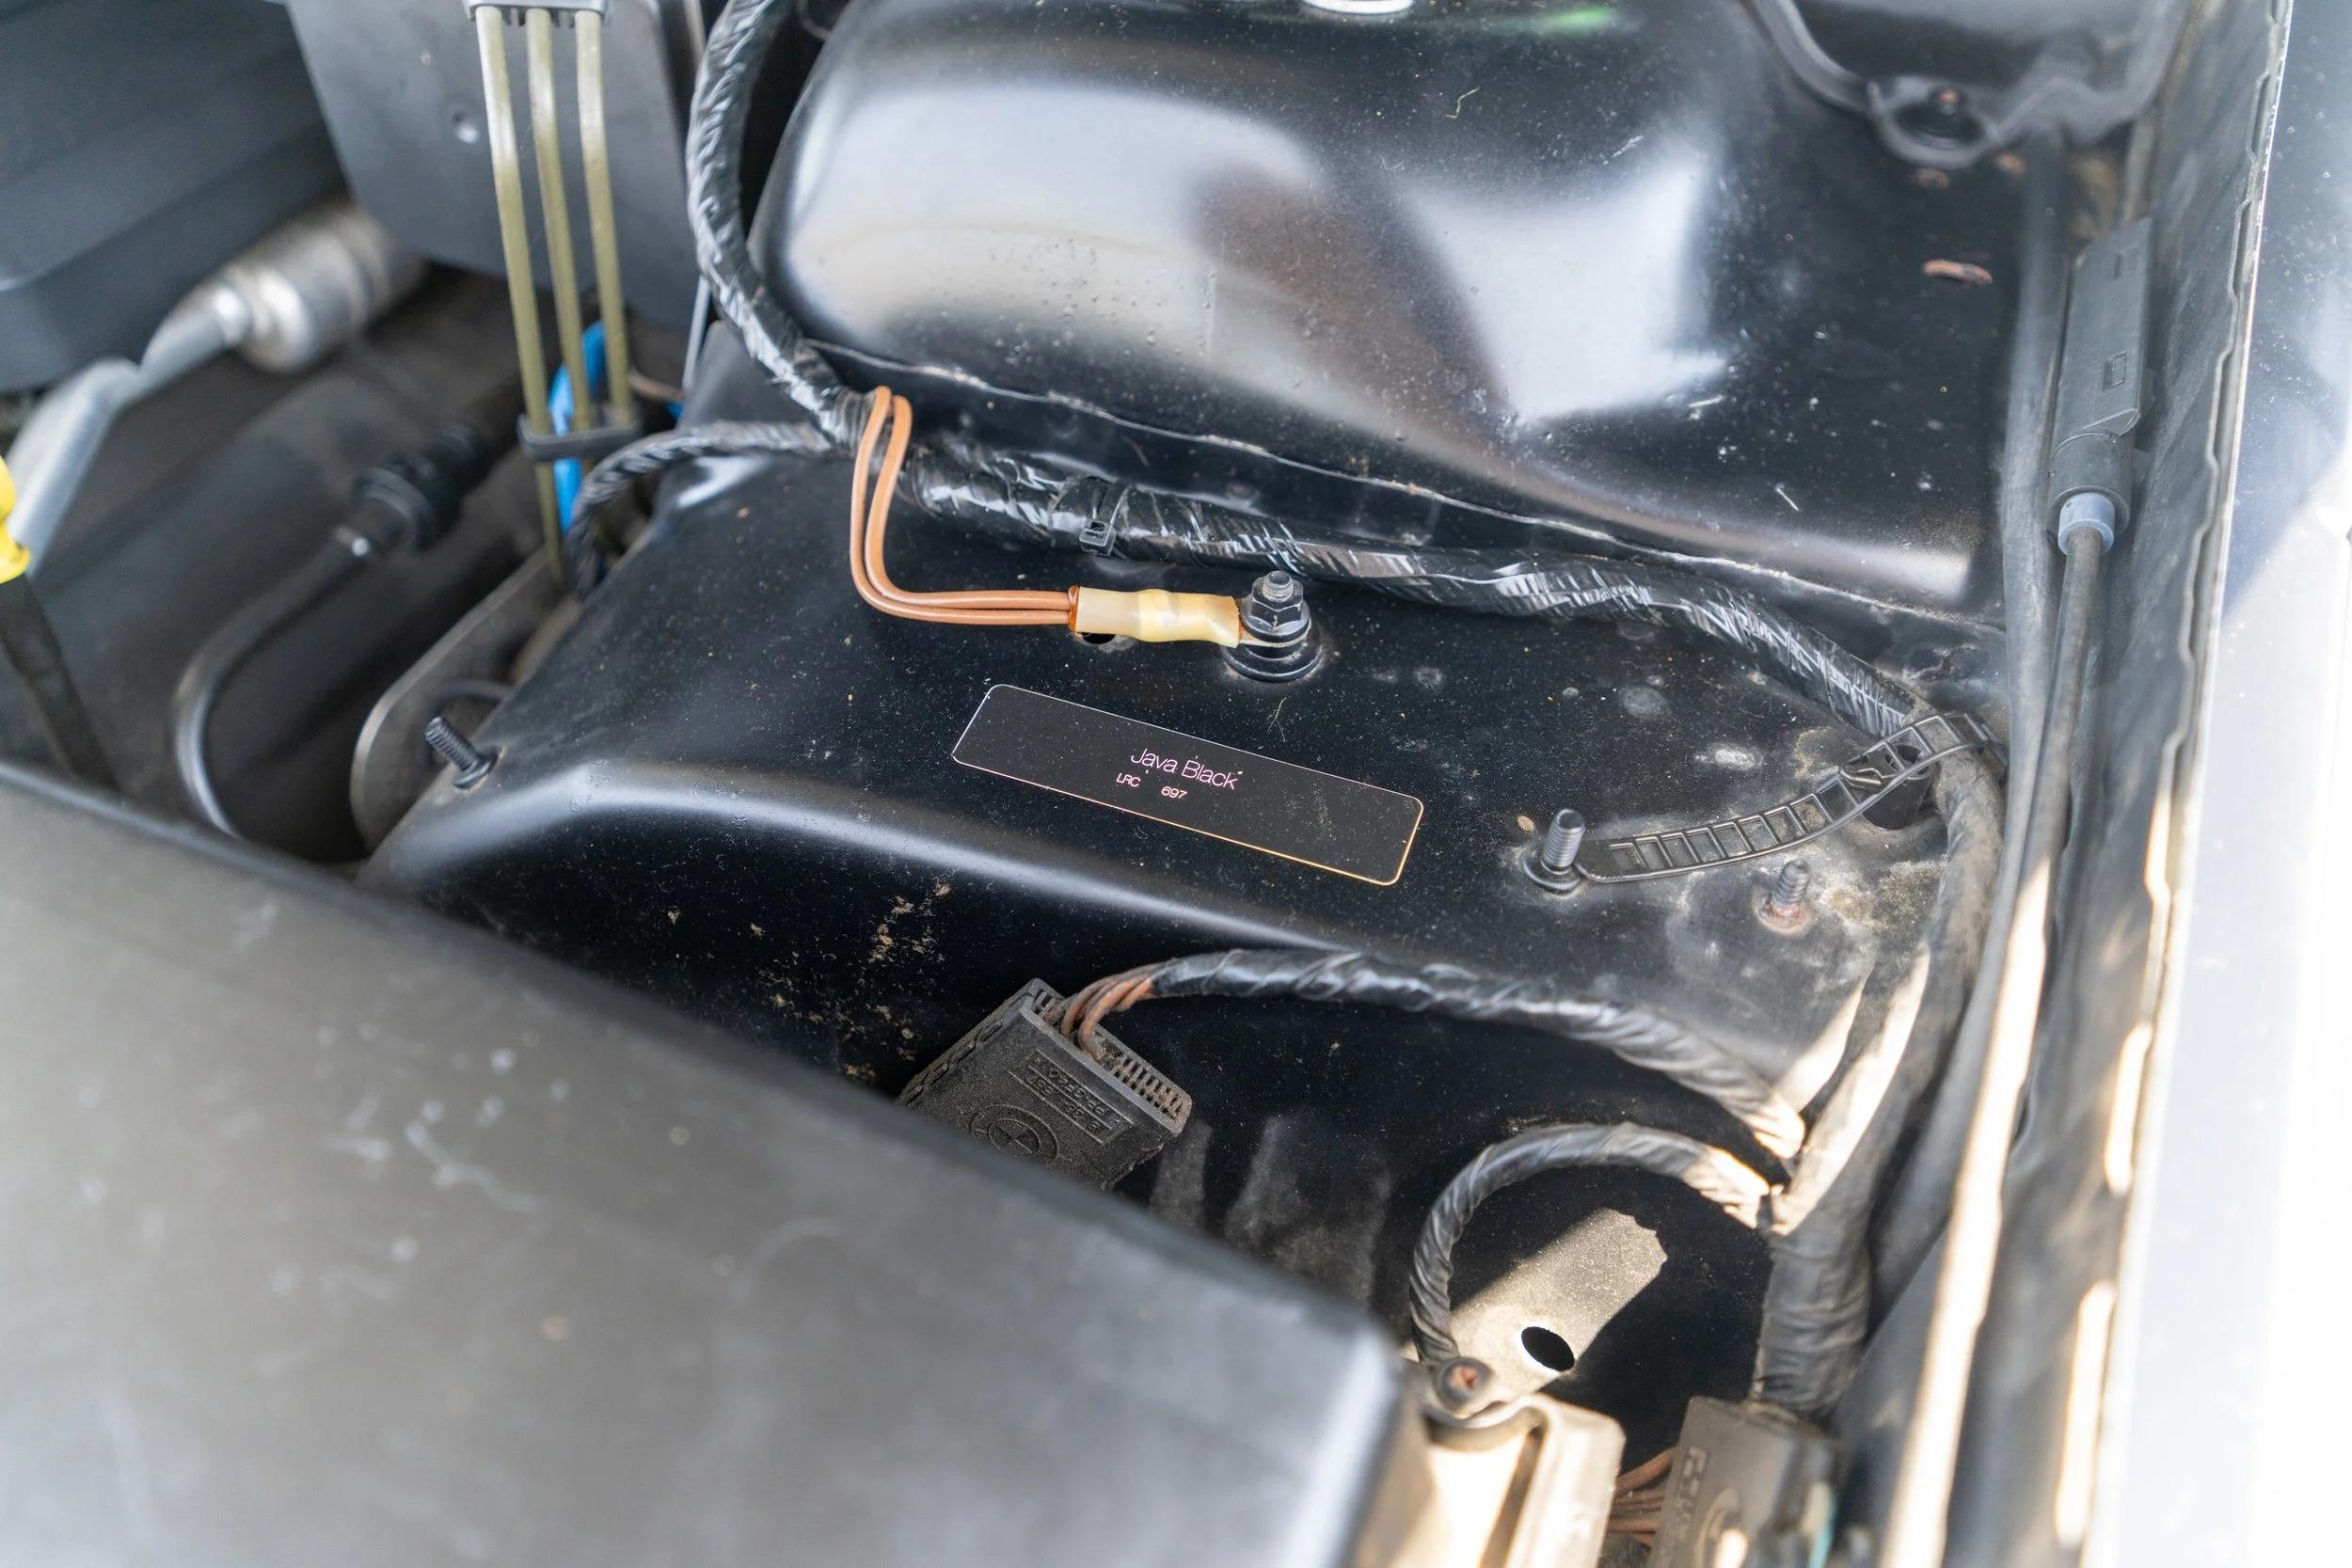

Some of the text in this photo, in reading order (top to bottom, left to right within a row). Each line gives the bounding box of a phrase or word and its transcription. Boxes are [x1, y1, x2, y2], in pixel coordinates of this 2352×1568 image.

[1116, 772, 1187, 800] LRC 697
[1131, 748, 1238, 790] Java Black
